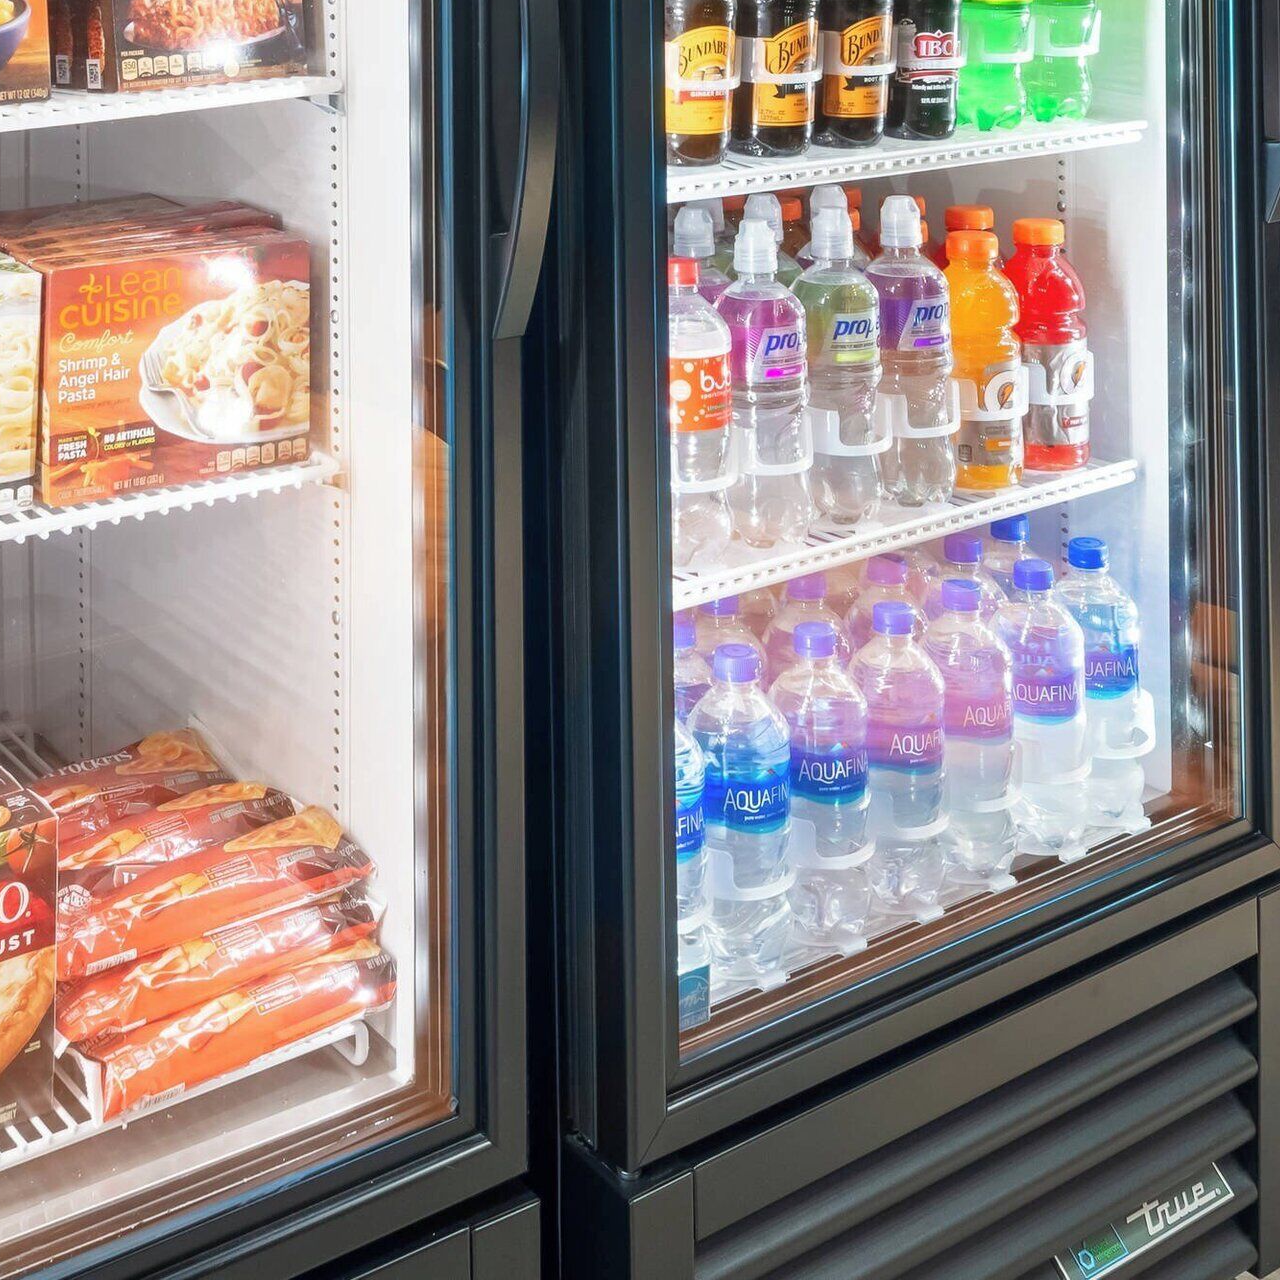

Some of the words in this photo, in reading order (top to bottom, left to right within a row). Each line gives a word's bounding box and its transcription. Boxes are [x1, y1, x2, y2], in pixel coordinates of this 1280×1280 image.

[919, 39, 955, 58] IBC
[105, 267, 183, 299] Lean
[59, 328, 134, 354] Comfort
[59, 354, 109, 376] Shrimp
[111, 353, 121, 366] &
[58, 371, 100, 391] Angel
[103, 368, 131, 384] Hair
[58, 387, 96, 405] Pasta
[104, 433, 116, 444] NO
[116, 427, 155, 441] ARTIFICIAL
[58, 440, 87, 452] FRESH
[58, 450, 87, 462] PASTA
